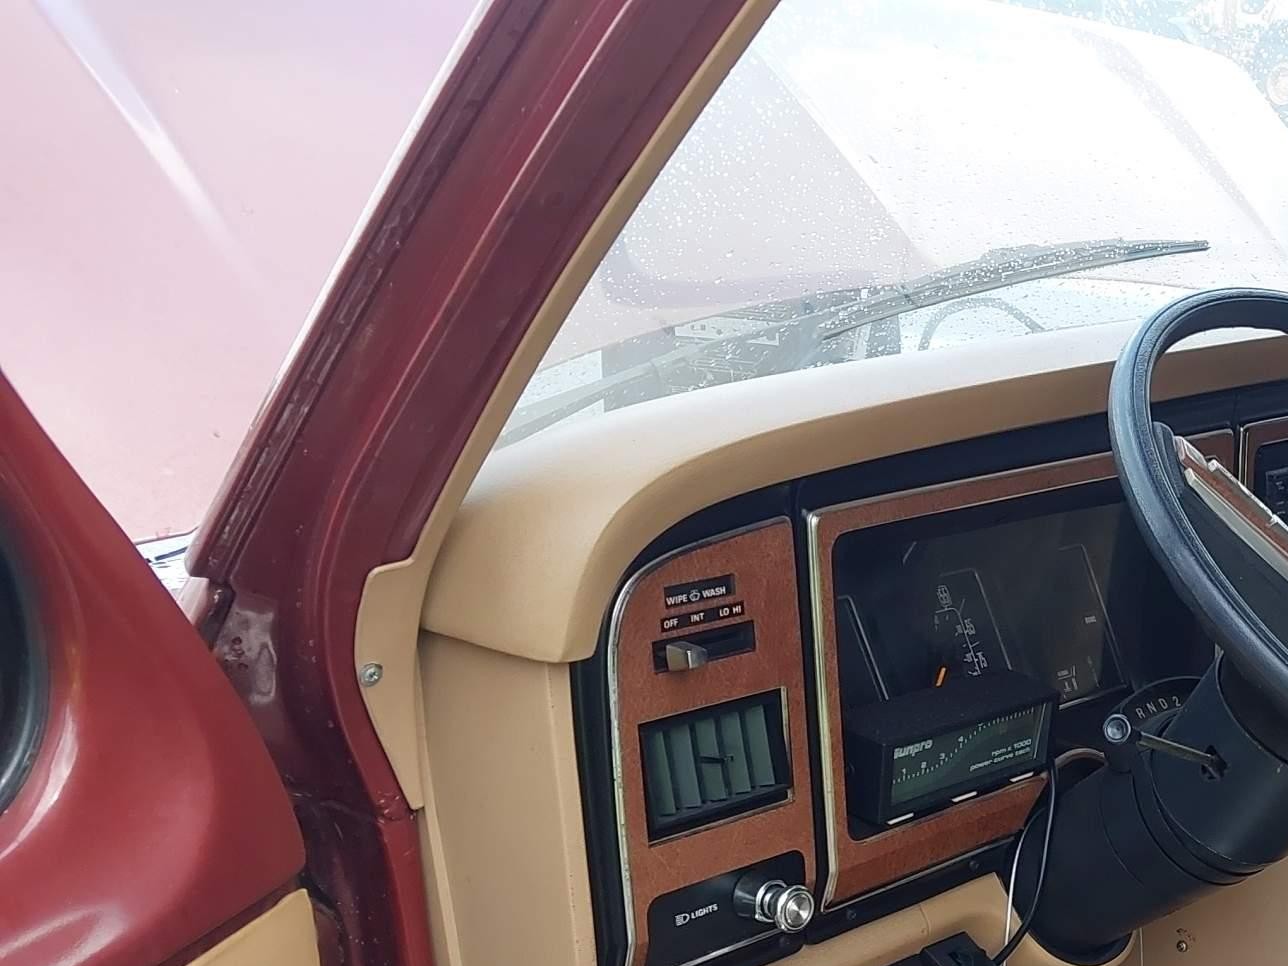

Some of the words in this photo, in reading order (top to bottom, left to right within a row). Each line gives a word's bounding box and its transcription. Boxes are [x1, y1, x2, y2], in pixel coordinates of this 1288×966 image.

[666, 594, 688, 606] WIPE
[701, 586, 726, 599] WASH
[664, 619, 678, 629] OFF
[691, 612, 705, 622] INT
[719, 608, 730, 617] LO
[733, 605, 741, 614] HI
[1136, 708, 1145, 719] R
[1147, 703, 1157, 713] N
[1158, 698, 1168, 708] D
[1172, 696, 1181, 706] 2
[691, 904, 718, 919] LIGHTS
